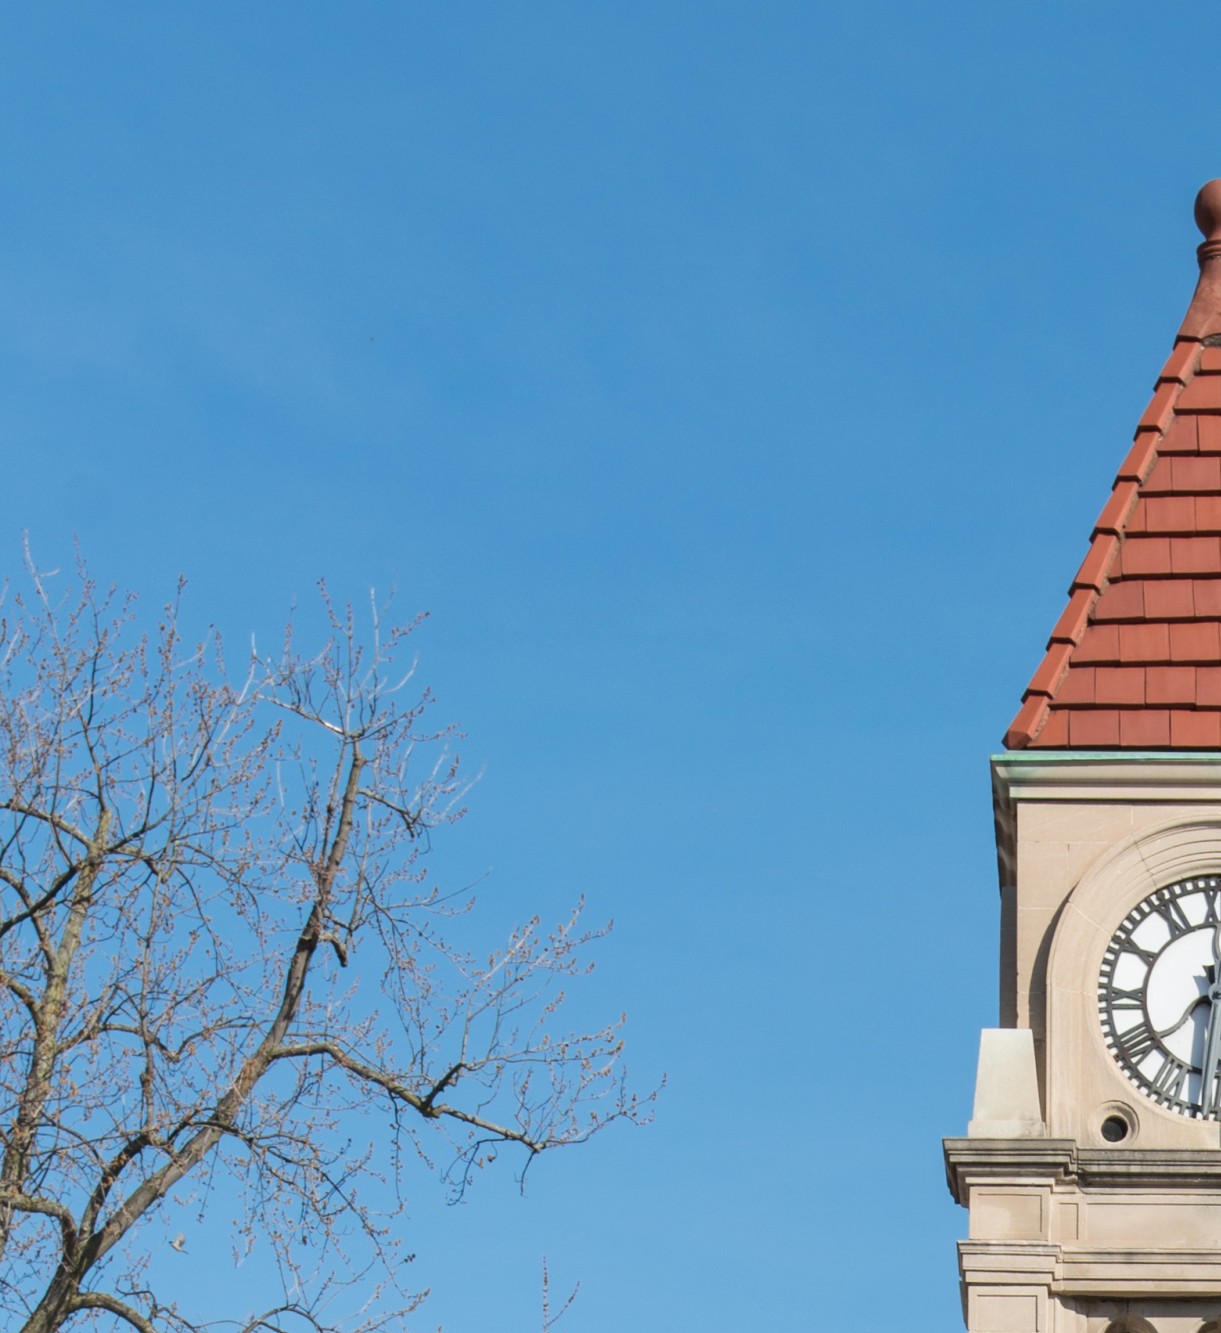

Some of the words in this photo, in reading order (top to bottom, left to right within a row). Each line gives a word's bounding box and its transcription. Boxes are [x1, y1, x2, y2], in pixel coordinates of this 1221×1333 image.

[1155, 896, 1192, 936] XI
[1116, 935, 1157, 964] X
[1109, 987, 1144, 1010] IX
[1153, 1057, 1188, 1101] VII
